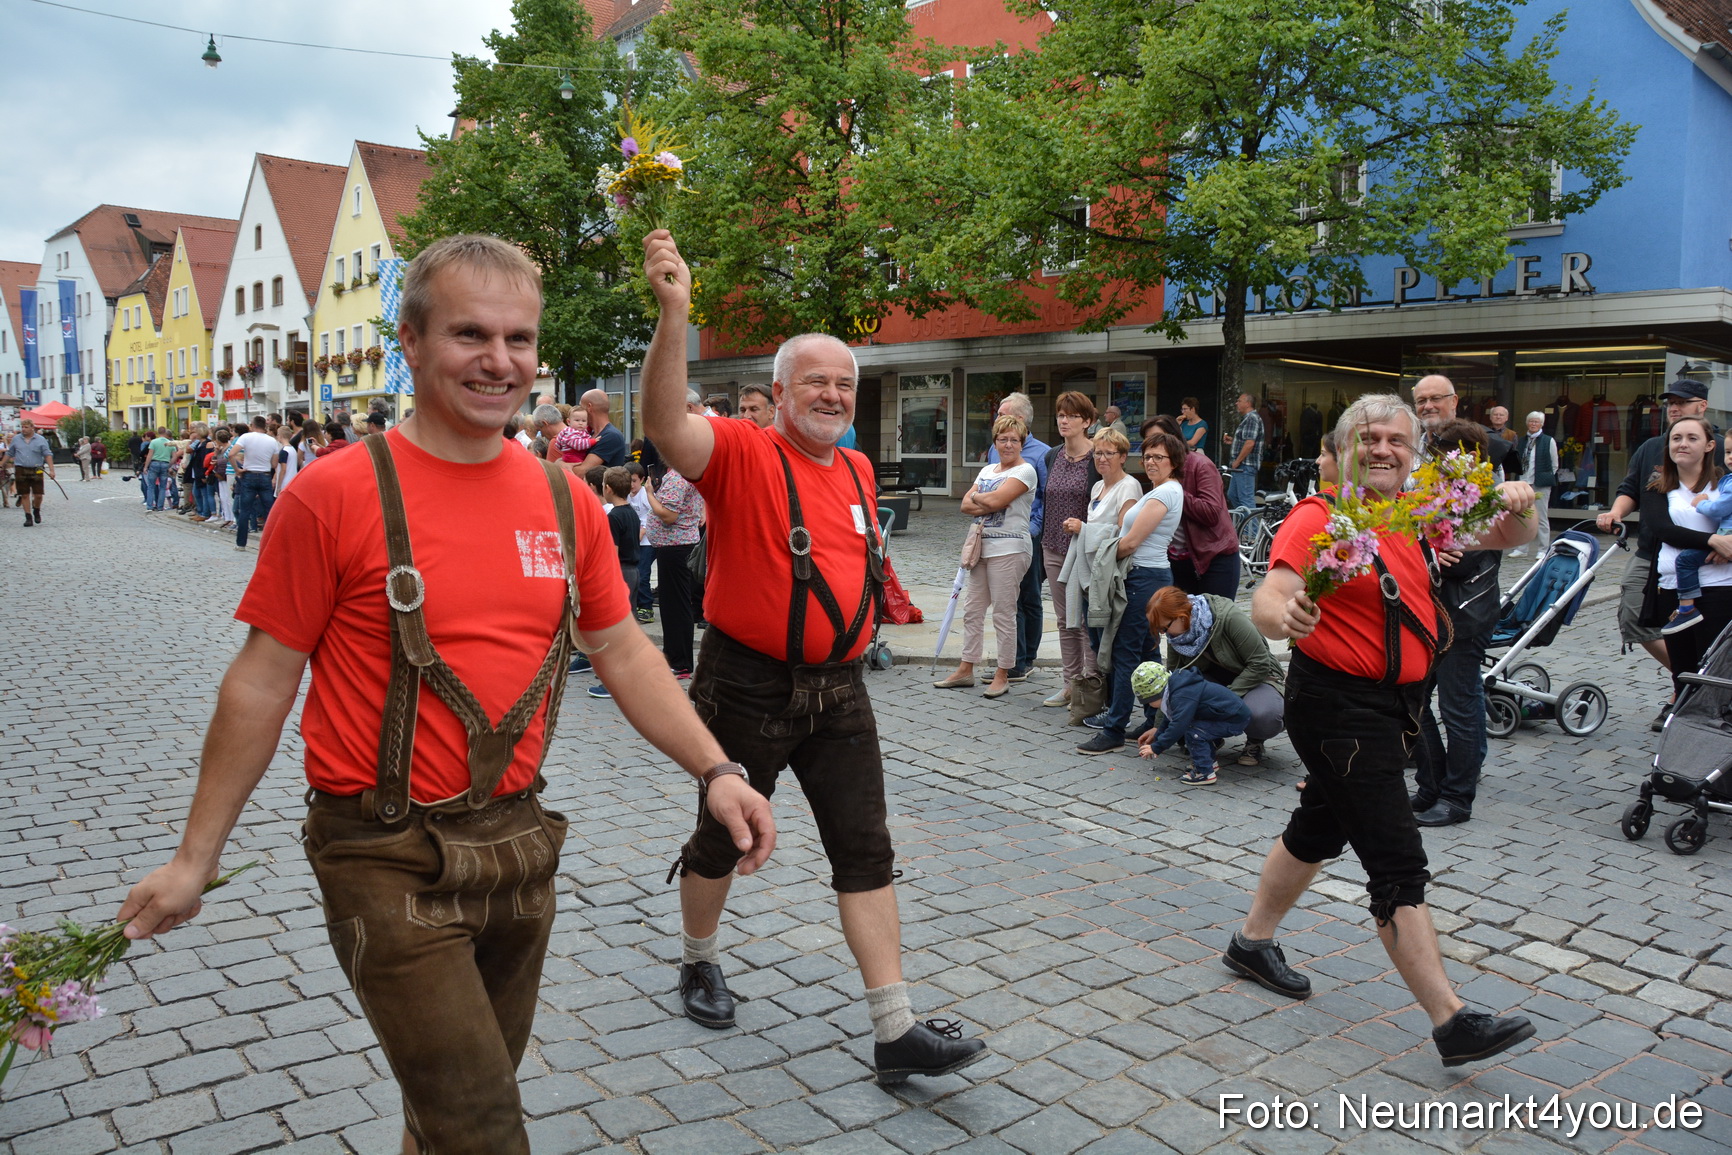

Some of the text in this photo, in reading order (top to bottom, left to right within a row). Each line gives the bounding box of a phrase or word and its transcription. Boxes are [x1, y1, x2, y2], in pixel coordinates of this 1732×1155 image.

[909, 301, 1102, 338] JOSEF ZNGER
[323, 386, 330, 399] P
